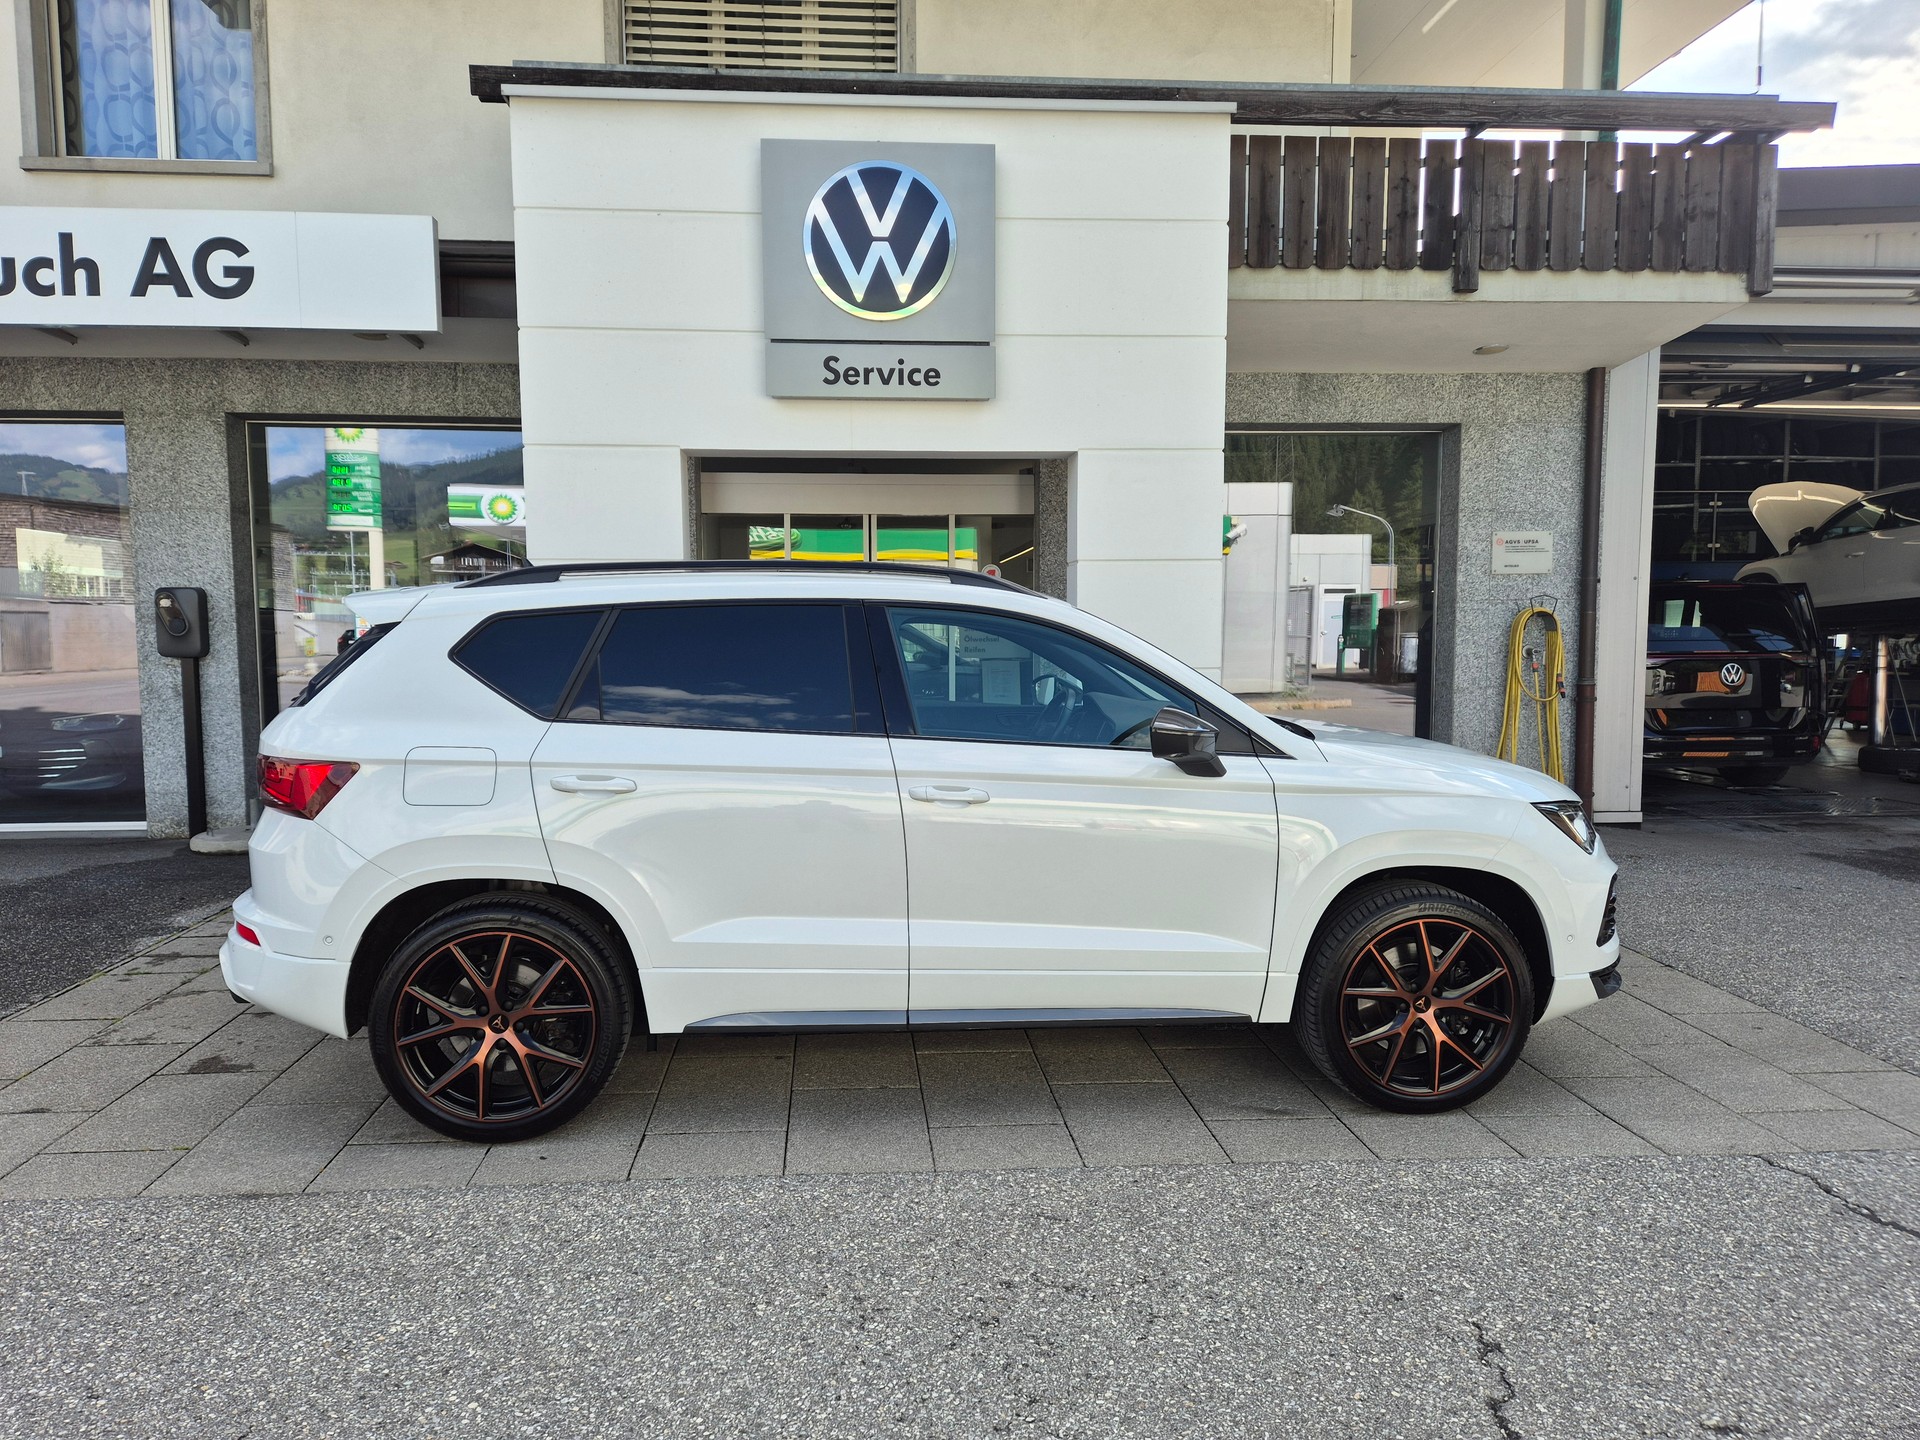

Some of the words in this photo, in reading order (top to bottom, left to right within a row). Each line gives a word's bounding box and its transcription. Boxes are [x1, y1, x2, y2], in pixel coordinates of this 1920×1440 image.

[129, 236, 255, 300] AG
[806, 163, 953, 312] VW
[822, 355, 941, 387] Service
